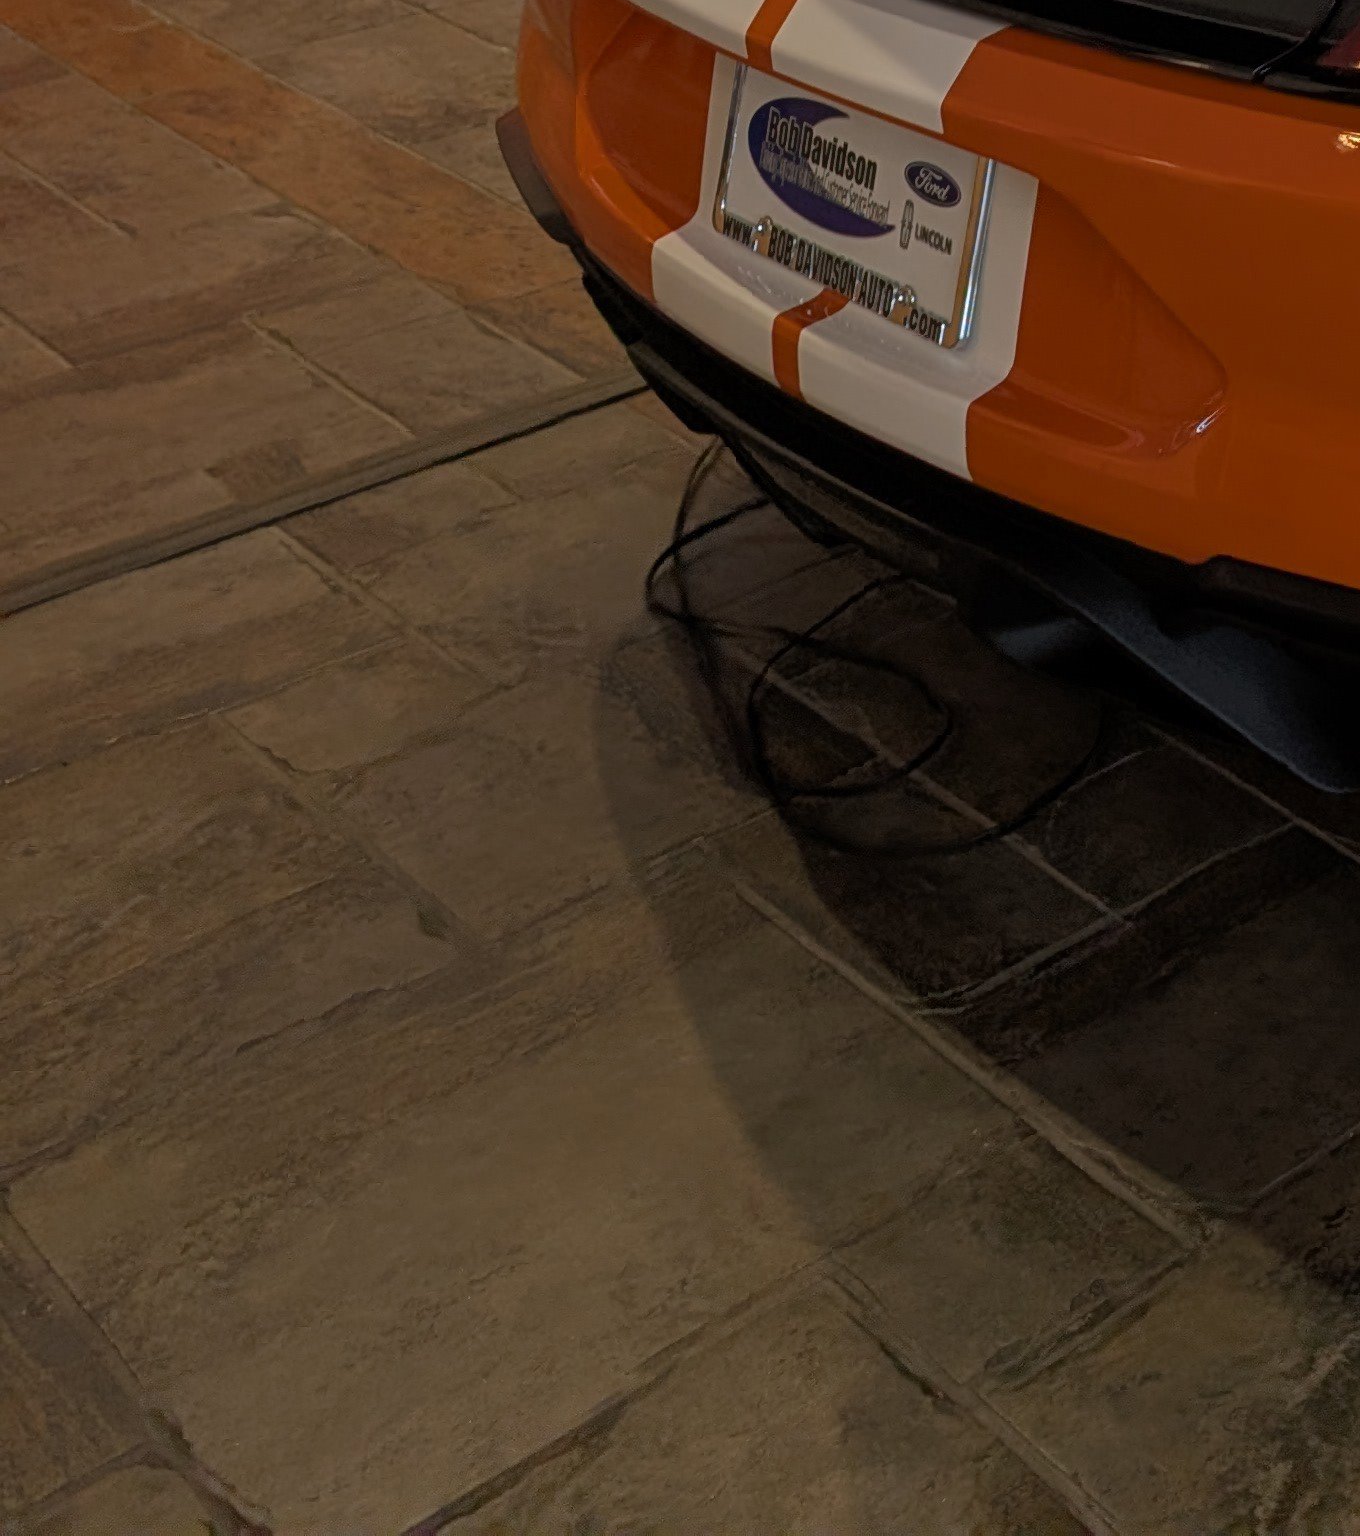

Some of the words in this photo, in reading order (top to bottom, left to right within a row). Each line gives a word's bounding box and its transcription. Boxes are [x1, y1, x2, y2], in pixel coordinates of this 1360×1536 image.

[767, 106, 801, 154] Bob
[800, 122, 877, 191] Davidson
[914, 166, 950, 201] Ford
[915, 222, 953, 256] LINCOLN
